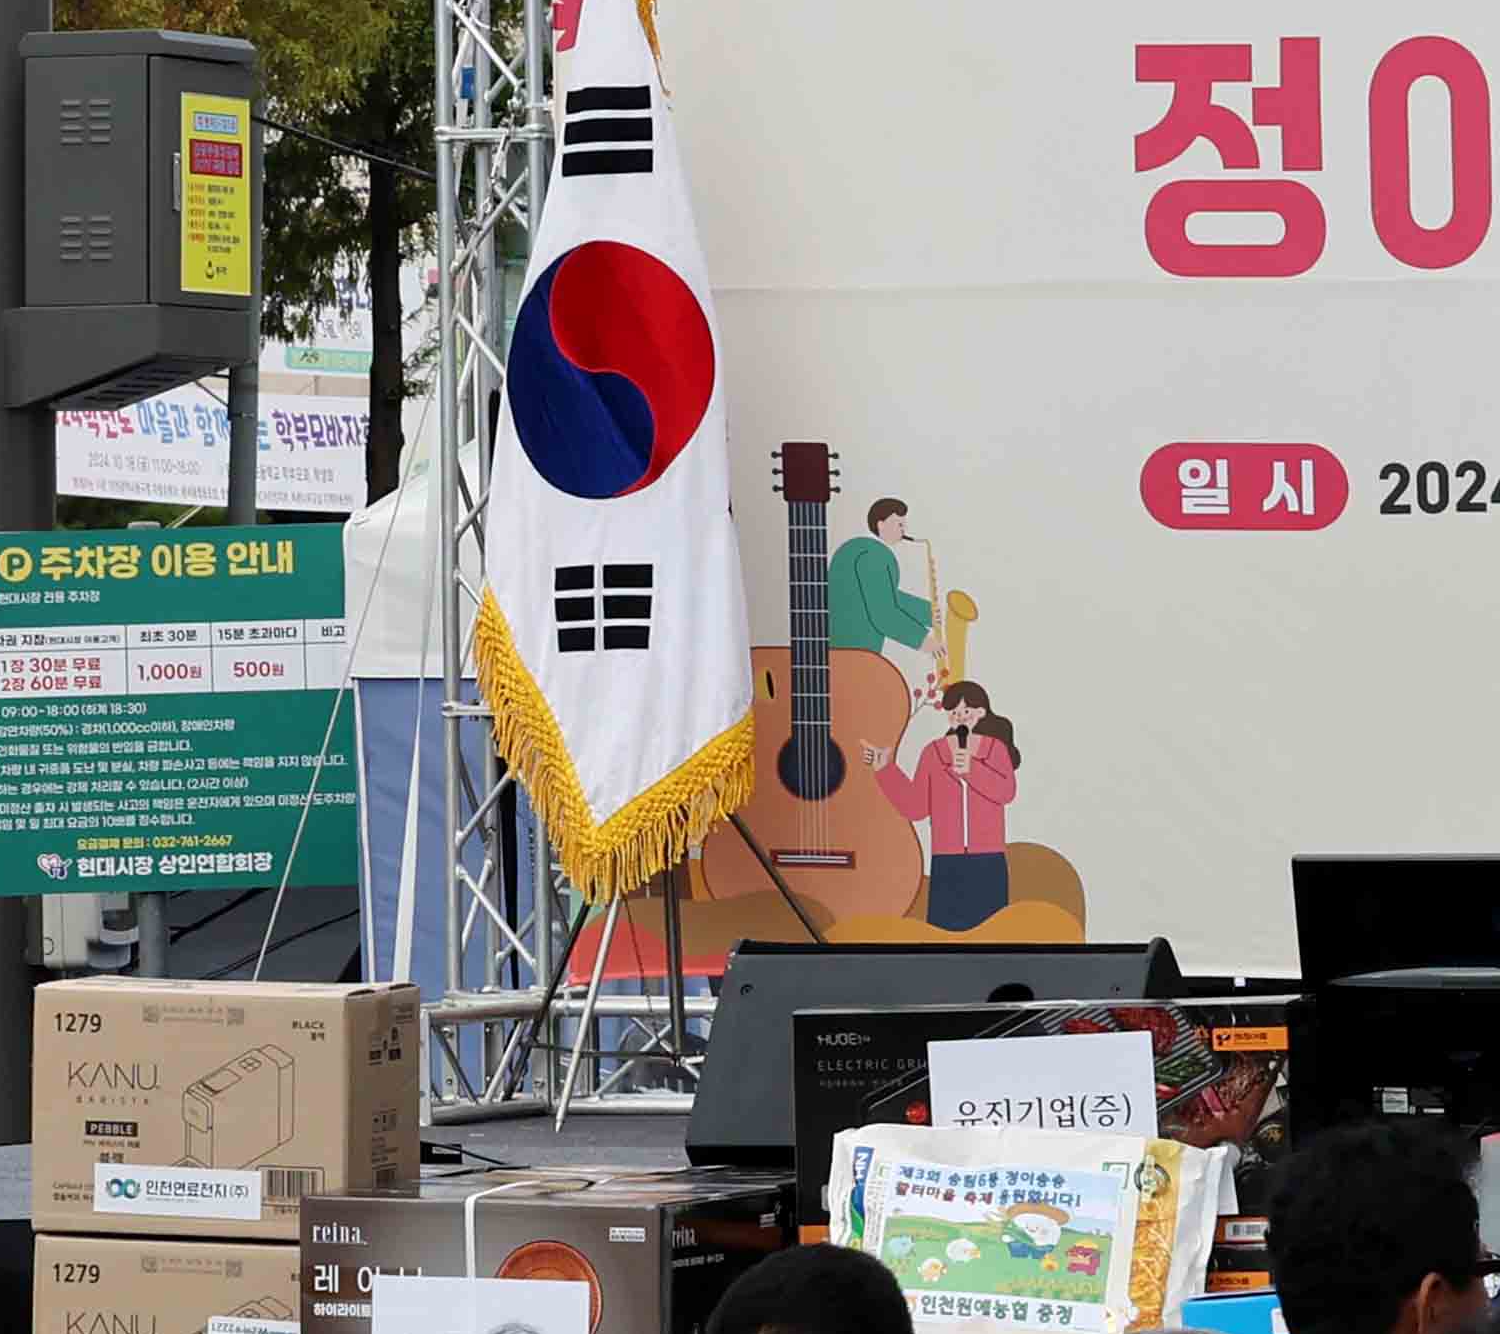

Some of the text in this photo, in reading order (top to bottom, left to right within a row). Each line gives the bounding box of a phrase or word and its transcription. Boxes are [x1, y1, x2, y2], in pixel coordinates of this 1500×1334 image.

[40, 545, 142, 581] 주차장
[151, 543, 217, 578] 이용
[226, 540, 294, 576] 안내
[140, 630, 166, 642] 최초
[167, 629, 197, 642] 30분
[218, 628, 245, 641] 15분
[249, 626, 298, 639] 초과마다
[1, 657, 102, 674] 1장 30분 무료
[137, 664, 202, 680] 1,000원
[233, 661, 285, 678] 500원
[1, 675, 102, 692] 2장 60분 무료
[109, 703, 148, 716] 18:30)
[151, 834, 234, 849] 032-761-2667
[77, 852, 272, 877] 현대시장 상인연합회장
[54, 1012, 102, 1034] 1279
[818, 1058, 889, 1073] ELECTRIC
[952, 1094, 1132, 1128] 유진기업(증)
[89, 1122, 134, 1136] PEBBLE
[947, 1170, 1000, 1189] 송림6동
[1004, 1170, 1067, 1190] 정이송송
[52, 1263, 101, 1284] 1279
[920, 1295, 1074, 1325] 인천원예농협 증정
